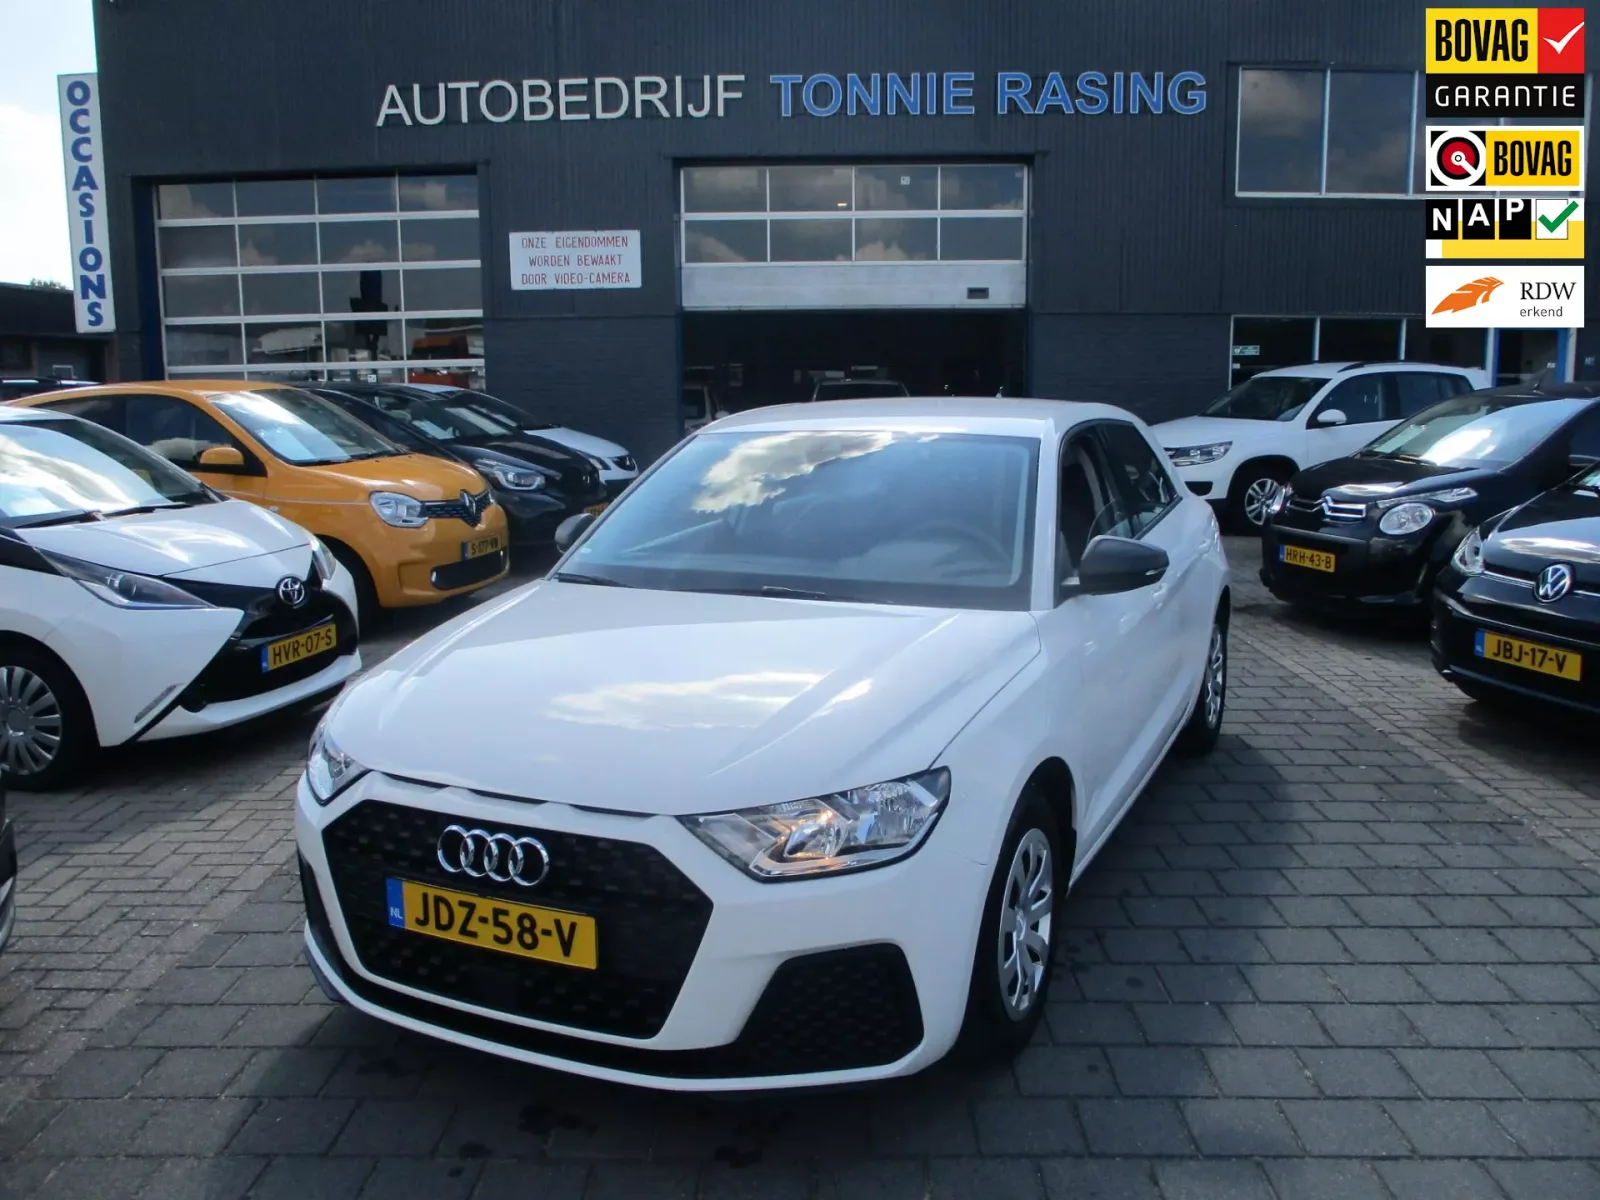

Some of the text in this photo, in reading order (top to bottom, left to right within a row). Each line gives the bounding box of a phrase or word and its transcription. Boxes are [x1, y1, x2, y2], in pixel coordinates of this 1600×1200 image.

[376, 71, 1207, 127] AUTOBEDRIJF TONNIE RASING
[66, 80, 107, 327] OCCASIONS
[521, 236, 629, 249] ONZE EIGENDOMMEN
[528, 254, 623, 267] WORDEN BEWAAKT
[521, 272, 631, 285] DOOR VIDEO-CAMERA
[1285, 547, 1332, 569] HRH-43-B
[272, 627, 332, 666] HVR-07-S
[1492, 639, 1567, 674] JBJ-17-V
[390, 906, 403, 919] NL
[415, 892, 578, 958] JDZ-58-V
